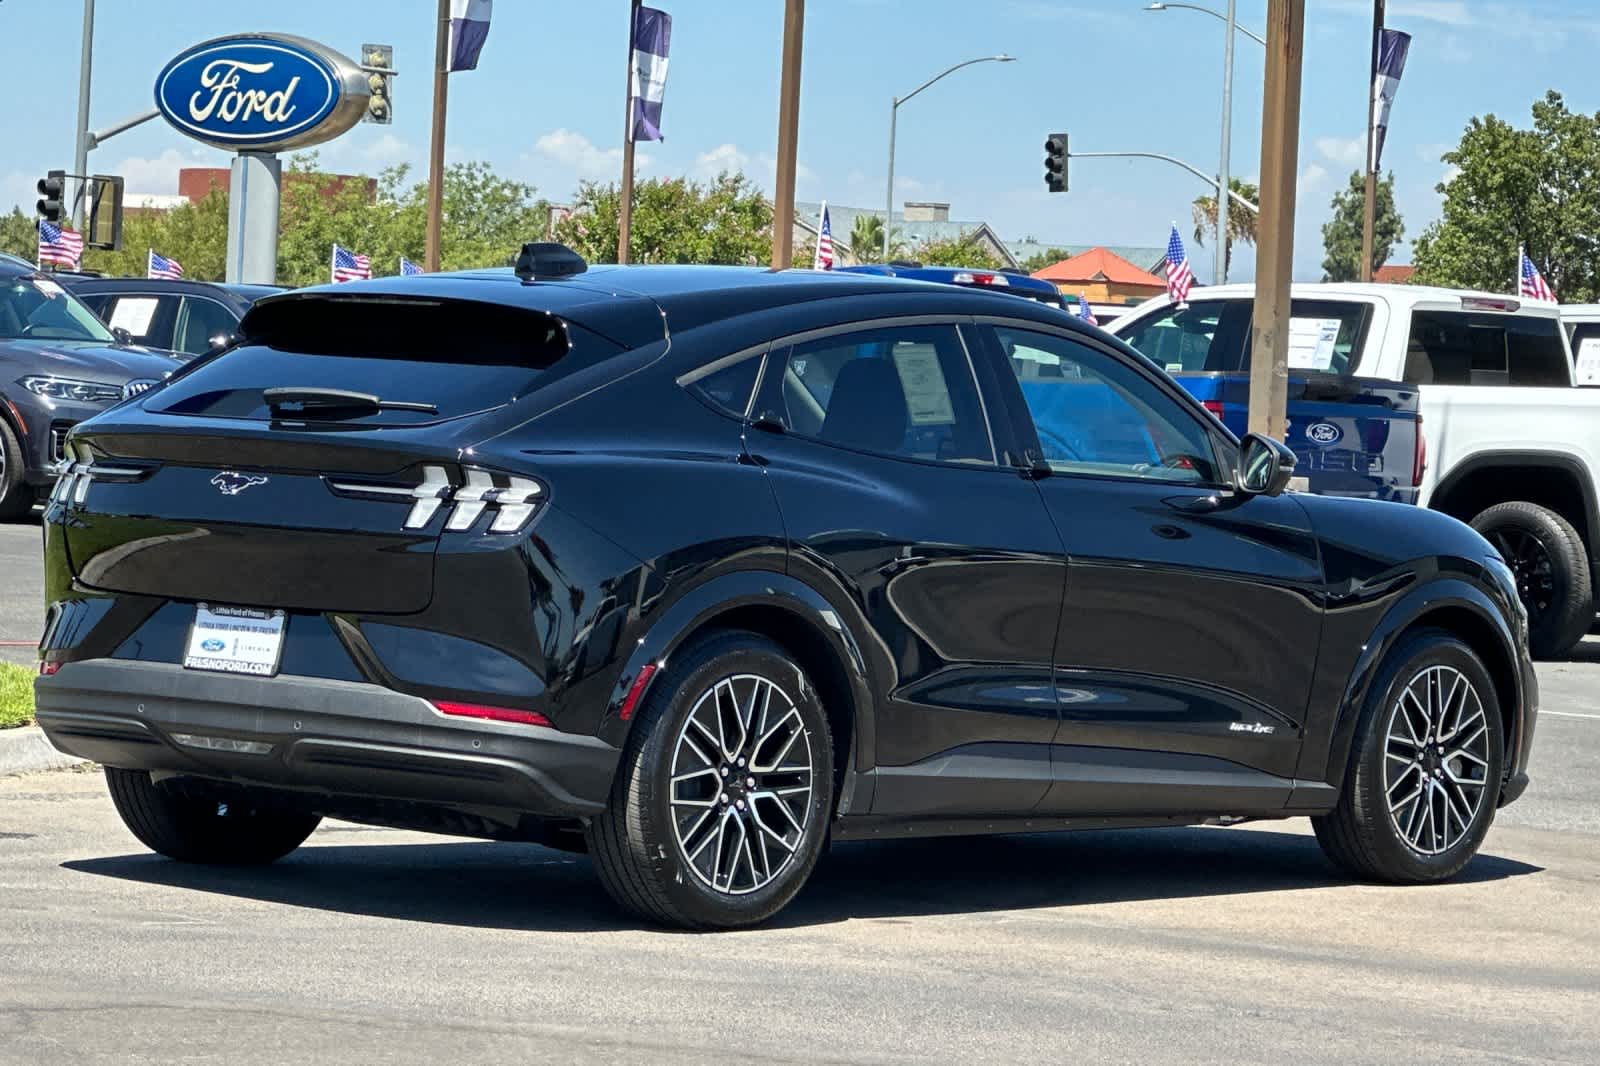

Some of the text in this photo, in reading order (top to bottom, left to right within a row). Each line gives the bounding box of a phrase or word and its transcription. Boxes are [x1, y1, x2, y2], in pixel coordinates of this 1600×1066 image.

[189, 59, 300, 121] Ford
[1314, 425, 1334, 439] Ford
[230, 608, 242, 616] Ford
